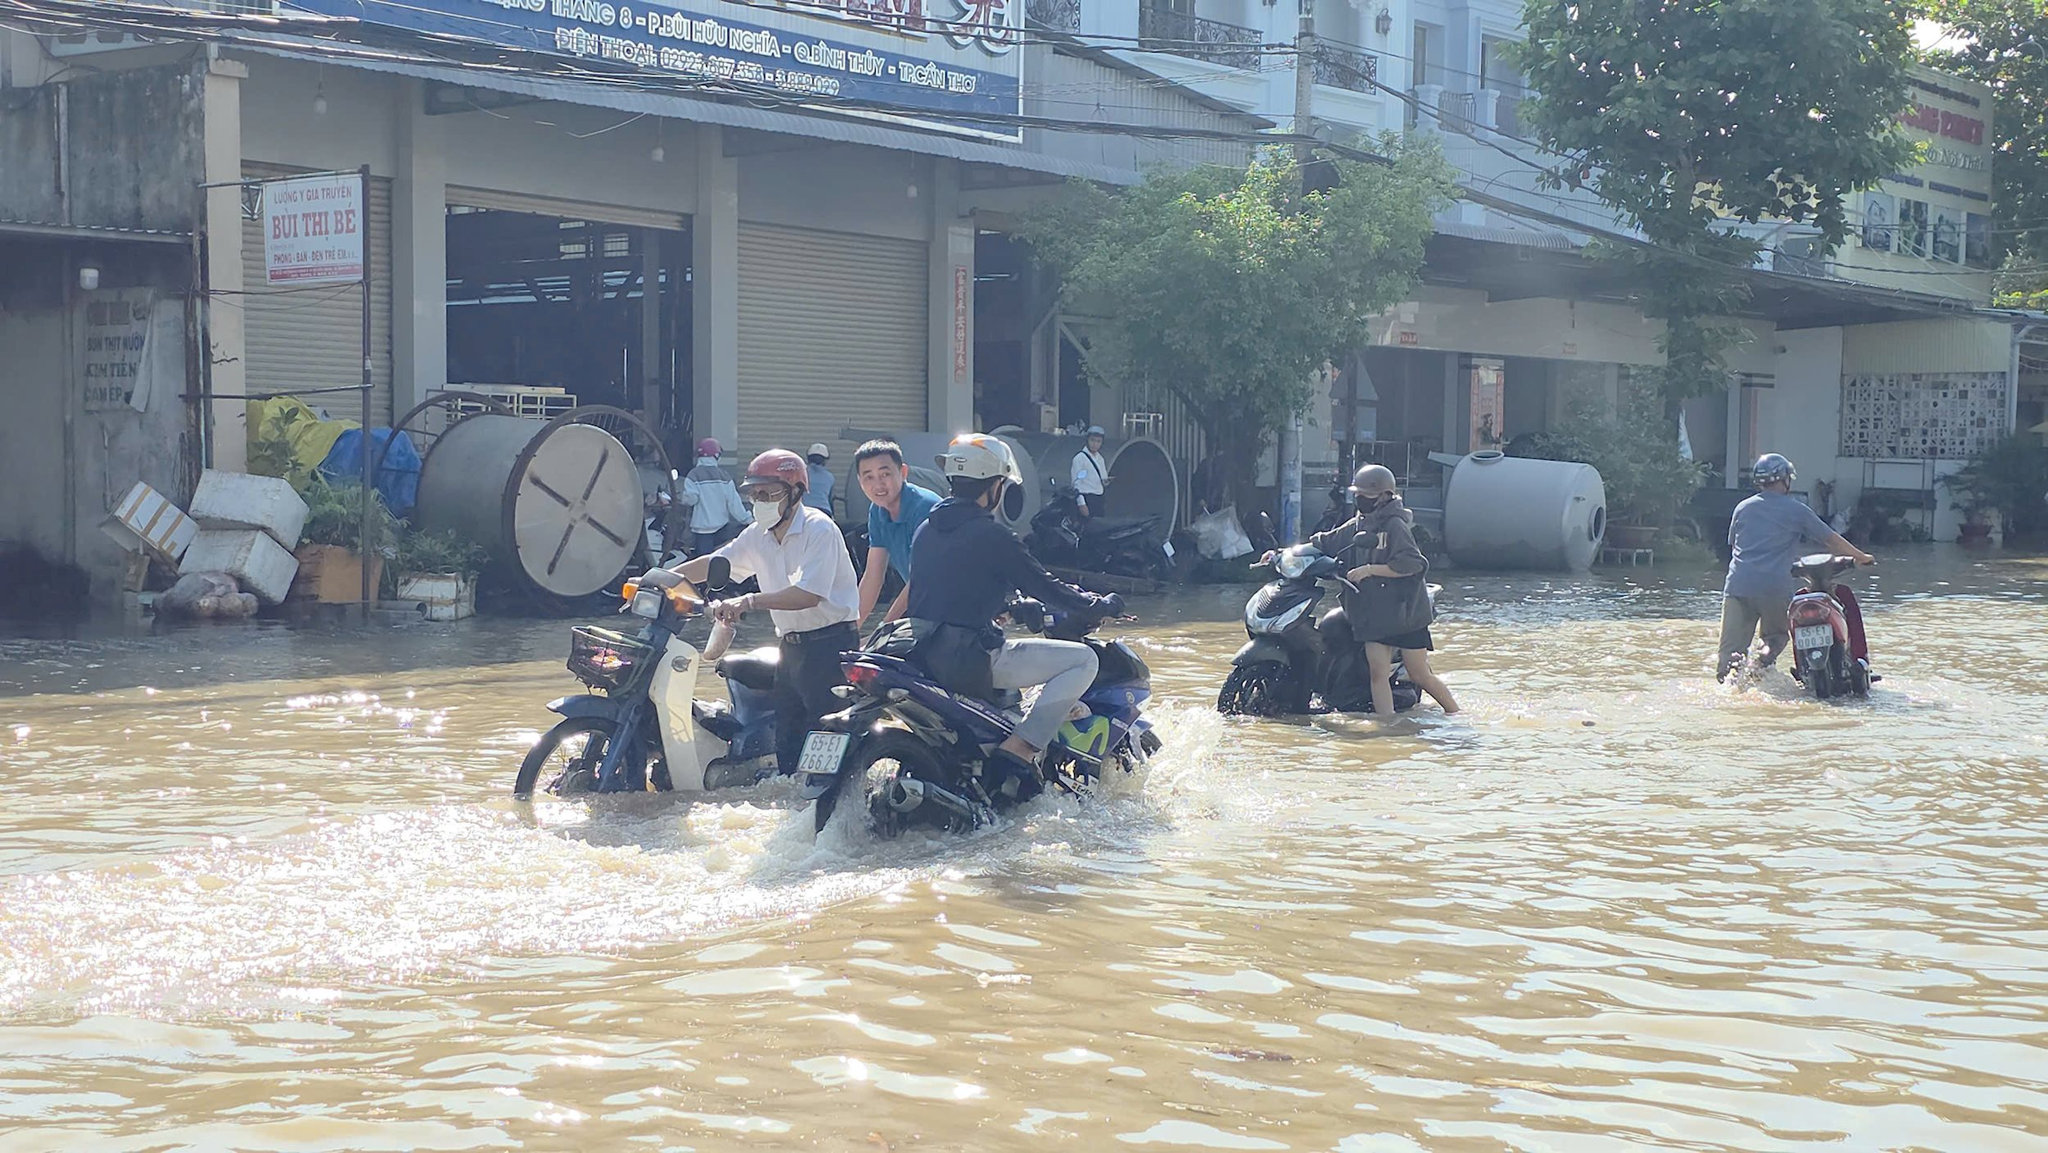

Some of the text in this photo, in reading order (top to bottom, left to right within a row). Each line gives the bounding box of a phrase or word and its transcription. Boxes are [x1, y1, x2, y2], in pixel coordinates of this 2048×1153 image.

[555, 26, 599, 57] ĐIỆN
[619, 7, 633, 29] 8
[692, 19, 729, 47] HỮU
[729, 28, 781, 58] NGHĨA
[794, 40, 845, 71] Q.BÌNH
[847, 50, 885, 77] THỦY
[948, 74, 977, 94] THƠ
[306, 189, 320, 202] GIA
[272, 201, 357, 241] BÙI THỊ BÉ
[810, 735, 842, 752] 65-E1
